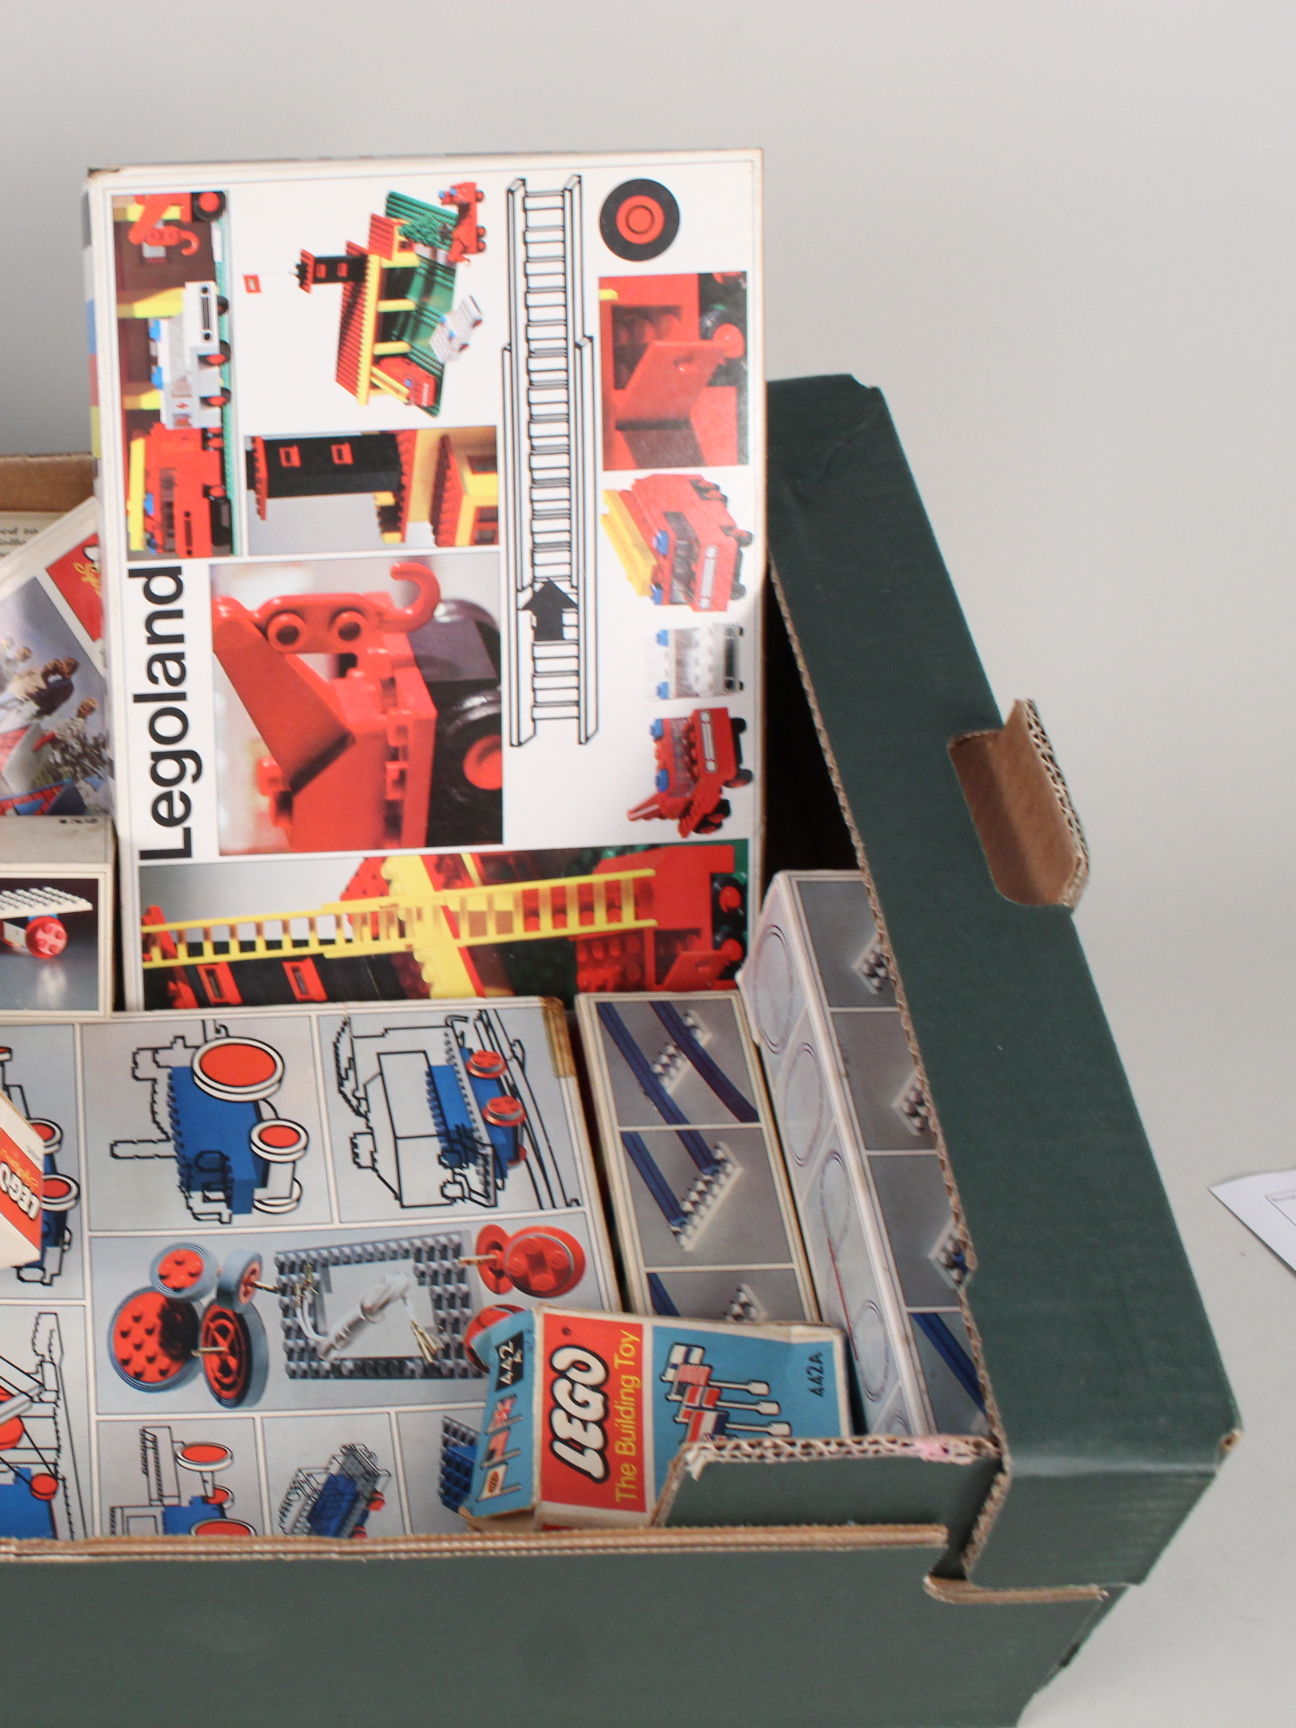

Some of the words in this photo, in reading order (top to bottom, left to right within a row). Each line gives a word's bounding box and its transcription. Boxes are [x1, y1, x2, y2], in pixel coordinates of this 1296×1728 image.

[128, 565, 203, 861] Legoland
[499, 1341, 515, 1385] 442
[614, 1329, 641, 1370] Toy
[806, 1351, 825, 1398] 442A
[551, 1344, 610, 1484] LEGO
[614, 1374, 641, 1457] Building
[615, 1462, 638, 1503] The
